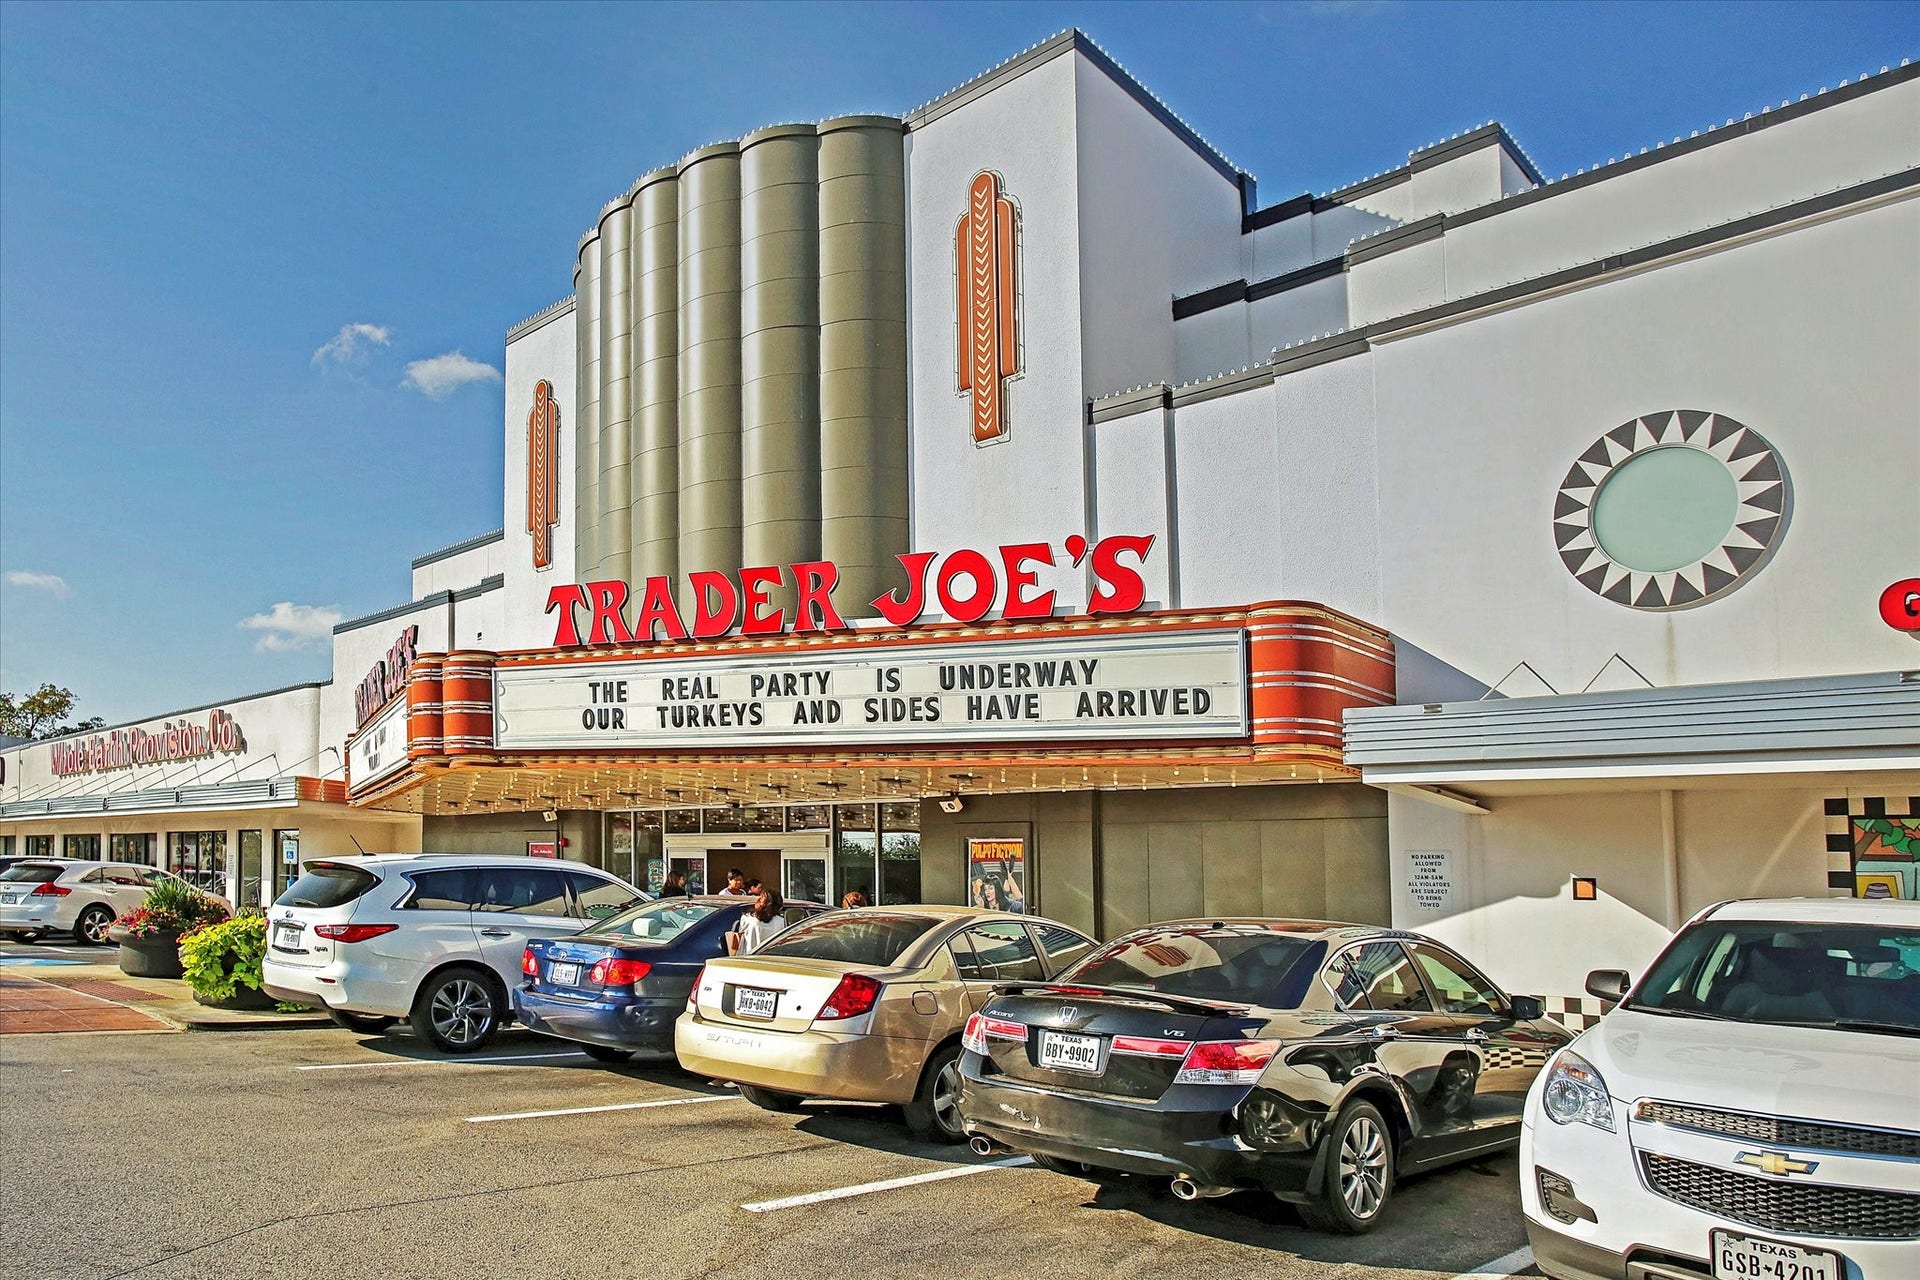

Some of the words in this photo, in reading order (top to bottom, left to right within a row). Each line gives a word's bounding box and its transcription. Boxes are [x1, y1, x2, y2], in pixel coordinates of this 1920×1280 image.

[545, 561, 847, 646] TRADER
[869, 534, 1156, 626] JOE'S
[588, 681, 628, 704] THE
[662, 676, 719, 701] REAL
[751, 671, 831, 697] PARTY
[876, 667, 900, 692] IS
[939, 659, 1098, 691] UNDERWAY
[582, 708, 625, 731] OUR
[656, 702, 763, 728] TURKEYS
[793, 700, 841, 725] AND
[865, 697, 940, 723] SIDES
[967, 693, 1039, 720] HAVE
[1076, 688, 1211, 718] ARRIVED
[51, 738, 84, 775] Whole
[88, 730, 124, 770] Earth
[128, 719, 204, 764] Provision
[209, 709, 239, 751] Co.
[751, 990, 766, 998] TEXAS
[989, 1009, 1014, 1018] Accord
[1060, 1035, 1083, 1044] TEXAS
[1163, 1028, 1185, 1037] V6
[1750, 1241, 1797, 1259] TEXAS
